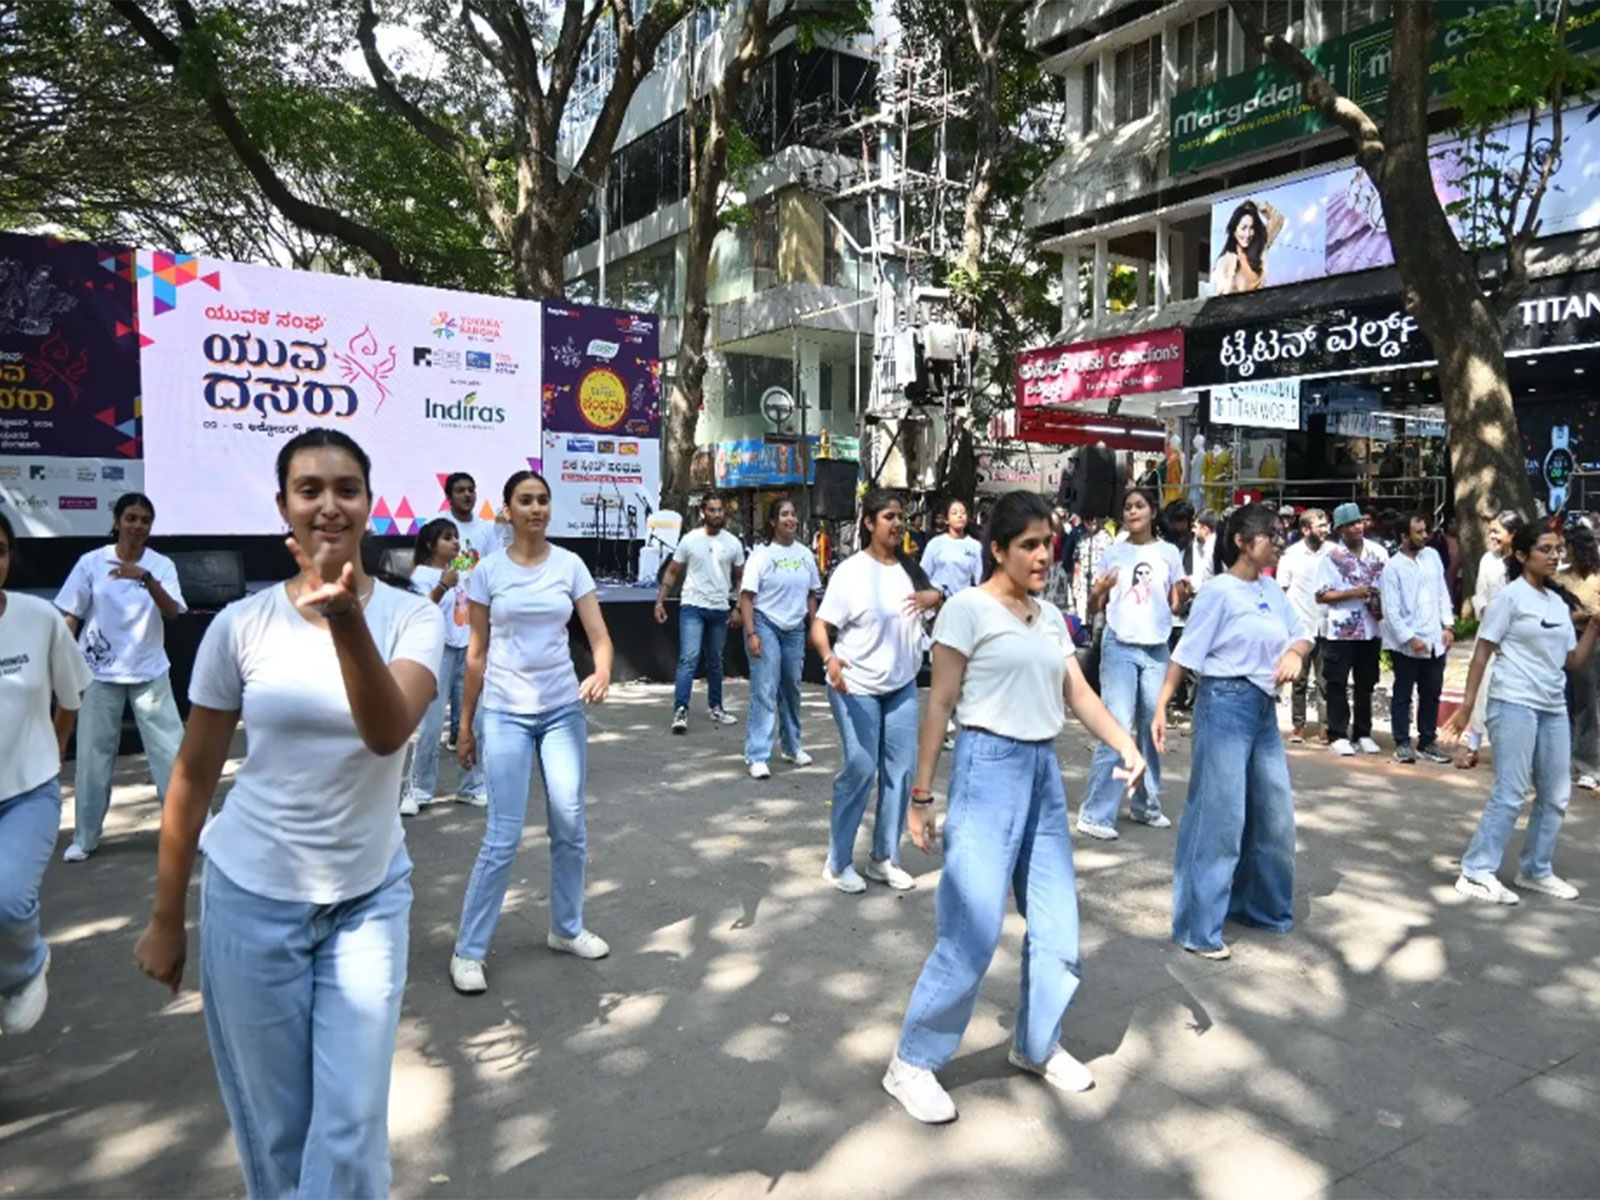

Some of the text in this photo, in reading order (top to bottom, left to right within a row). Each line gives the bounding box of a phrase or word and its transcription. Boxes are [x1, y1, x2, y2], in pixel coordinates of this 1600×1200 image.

[205, 304, 325, 333] ಯುವಕ ಸಂಘ
[459, 325, 501, 339] SANGHA
[460, 316, 501, 329] YUVAKA
[203, 330, 328, 372] ಯುವ
[1219, 323, 1318, 377] ಟೈಟನ್
[203, 370, 358, 419] ದಸರಾ
